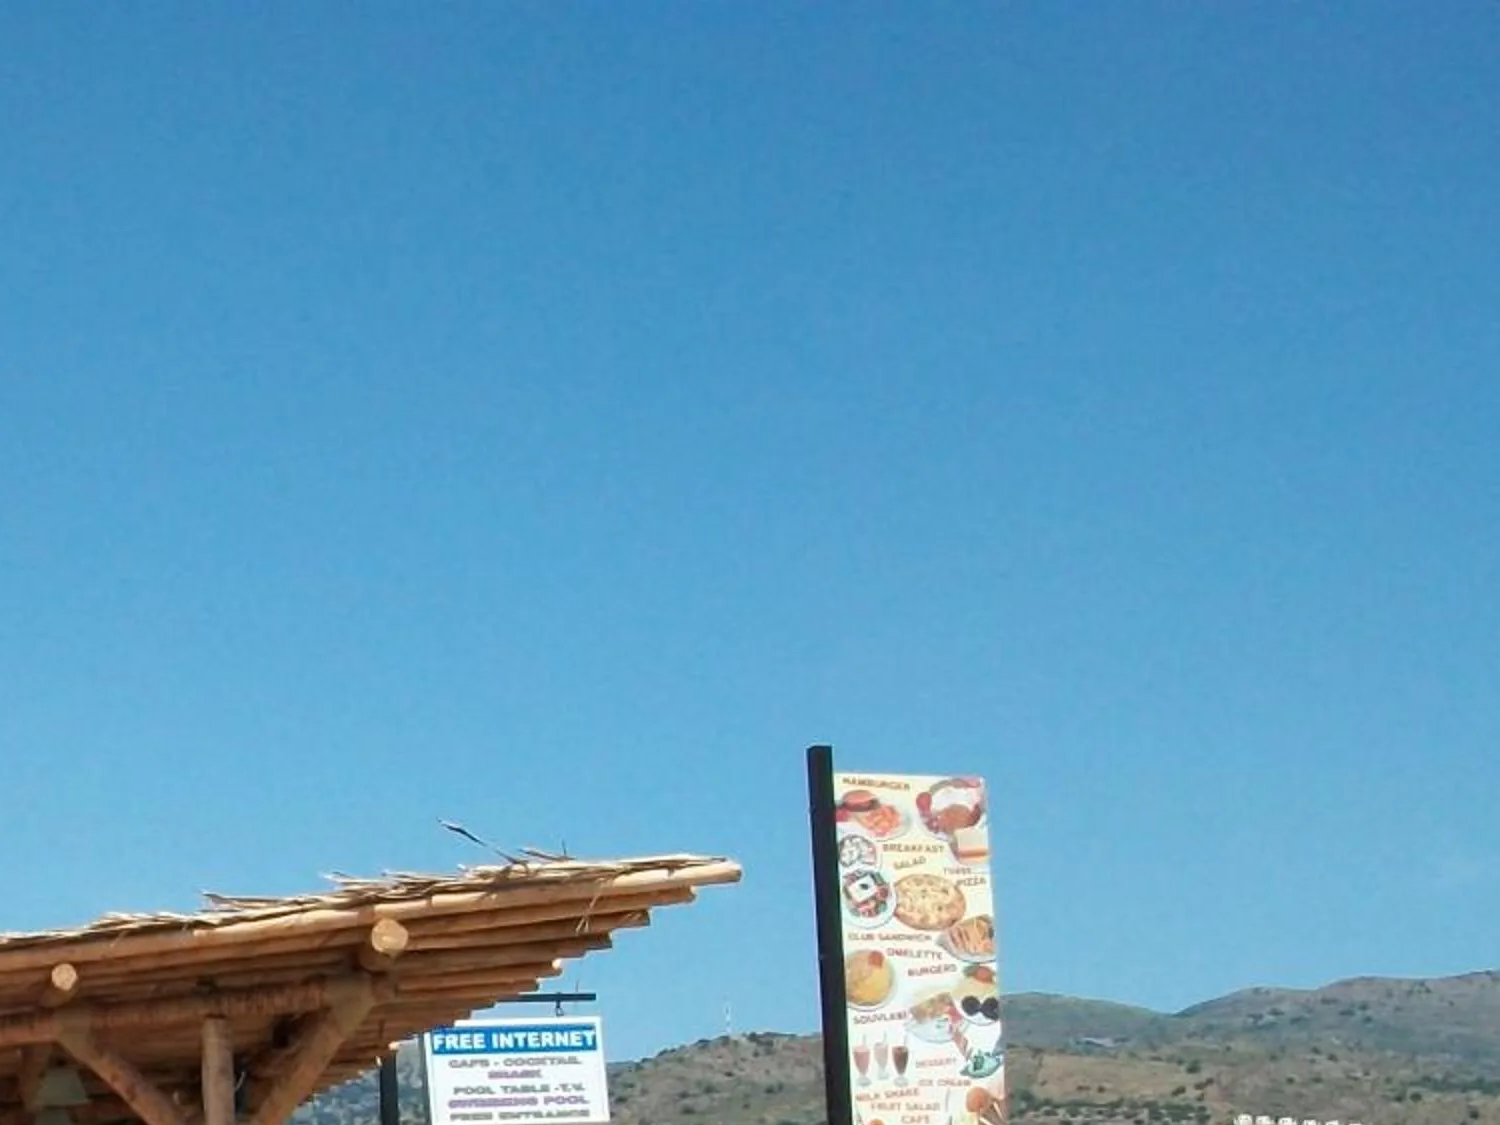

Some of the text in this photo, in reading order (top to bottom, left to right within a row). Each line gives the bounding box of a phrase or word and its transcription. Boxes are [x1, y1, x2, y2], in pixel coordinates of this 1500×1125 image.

[842, 777, 910, 791] HAMBURGER
[882, 843, 945, 852] BREAKFAST
[893, 856, 927, 869] SALAD
[956, 877, 986, 887] PIZZA
[848, 932, 932, 941] CLUB SANDWICH
[886, 947, 943, 960] OMELETTE
[908, 963, 958, 977] BURGERS
[433, 1029, 596, 1050] FREE INTERNET
[503, 1056, 582, 1067] COCKTAIL
[937, 1079, 972, 1087] CREAM
[454, 1086, 495, 1095] POOL
[500, 1084, 550, 1094] TABLE
[884, 1087, 920, 1099] SHAKE
[543, 1095, 590, 1105] POOL
[870, 1101, 941, 1111] FRUIT SALAD
